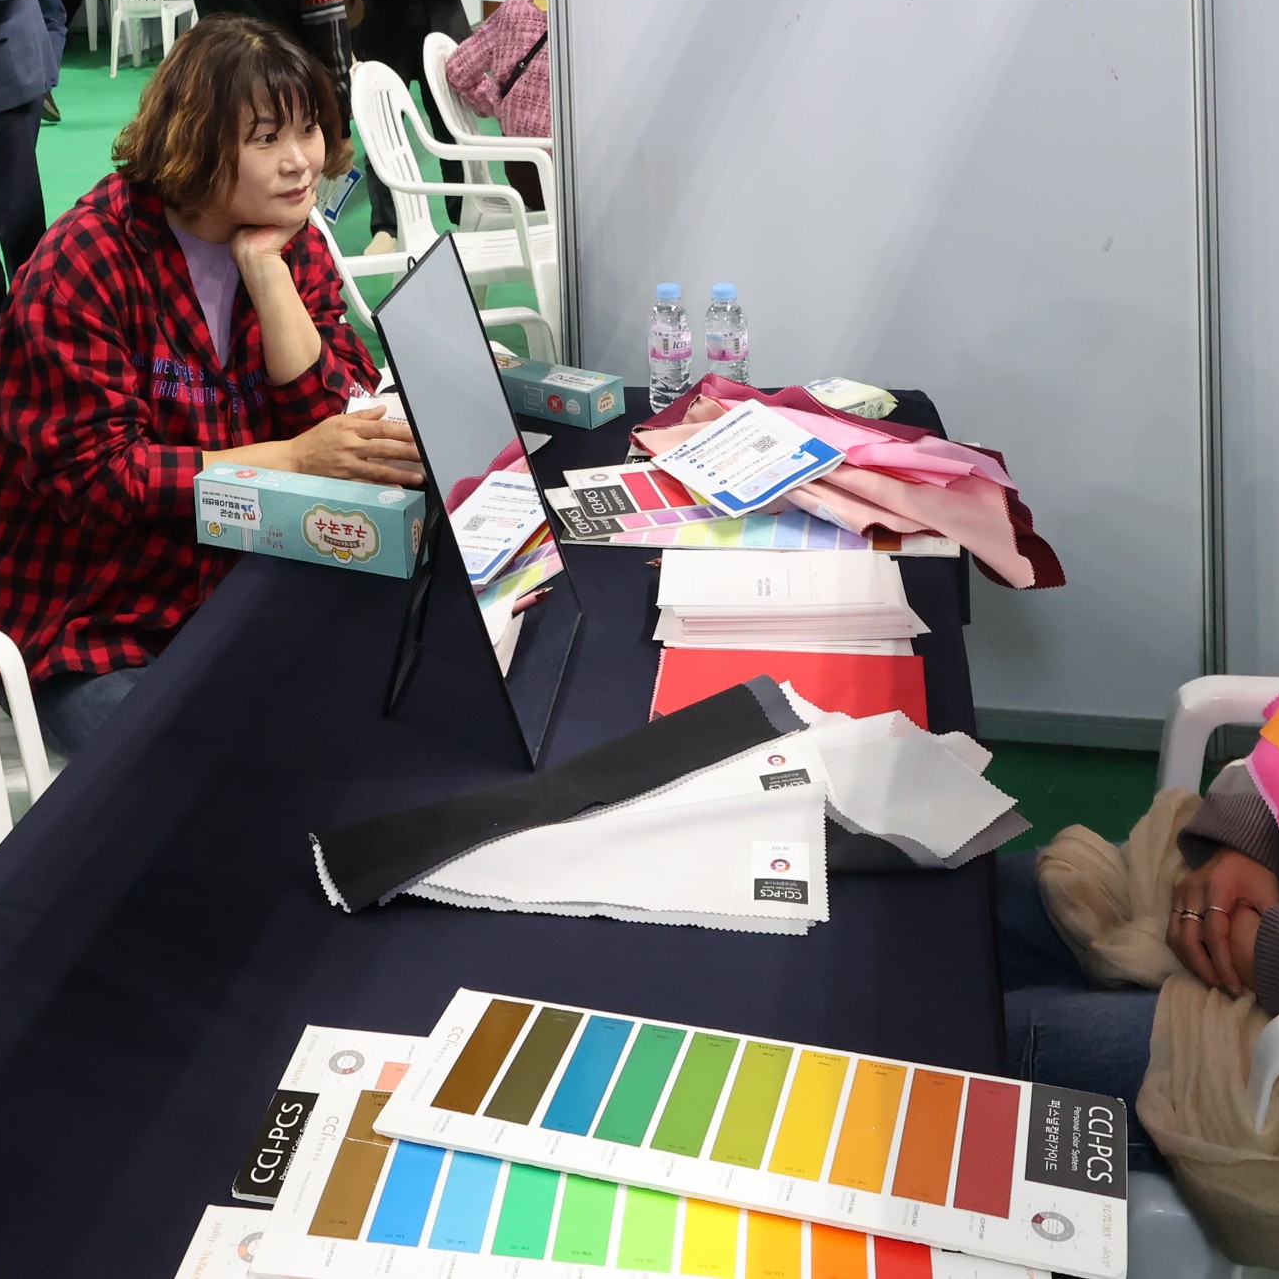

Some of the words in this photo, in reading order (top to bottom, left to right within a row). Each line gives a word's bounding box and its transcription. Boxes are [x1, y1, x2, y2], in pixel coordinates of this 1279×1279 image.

[315, 518, 368, 539] 구포국수
[759, 889, 803, 900] CCI-PCS
[1073, 1106, 1082, 1130] Personal
[250, 1102, 304, 1184] CCI-PCS
[1043, 1099, 1061, 1171] 퍼스널컬러가이드
[1072, 1130, 1081, 1148] Color
[1086, 1105, 1114, 1184] CCI-PCS
[1071, 1145, 1080, 1172] System
